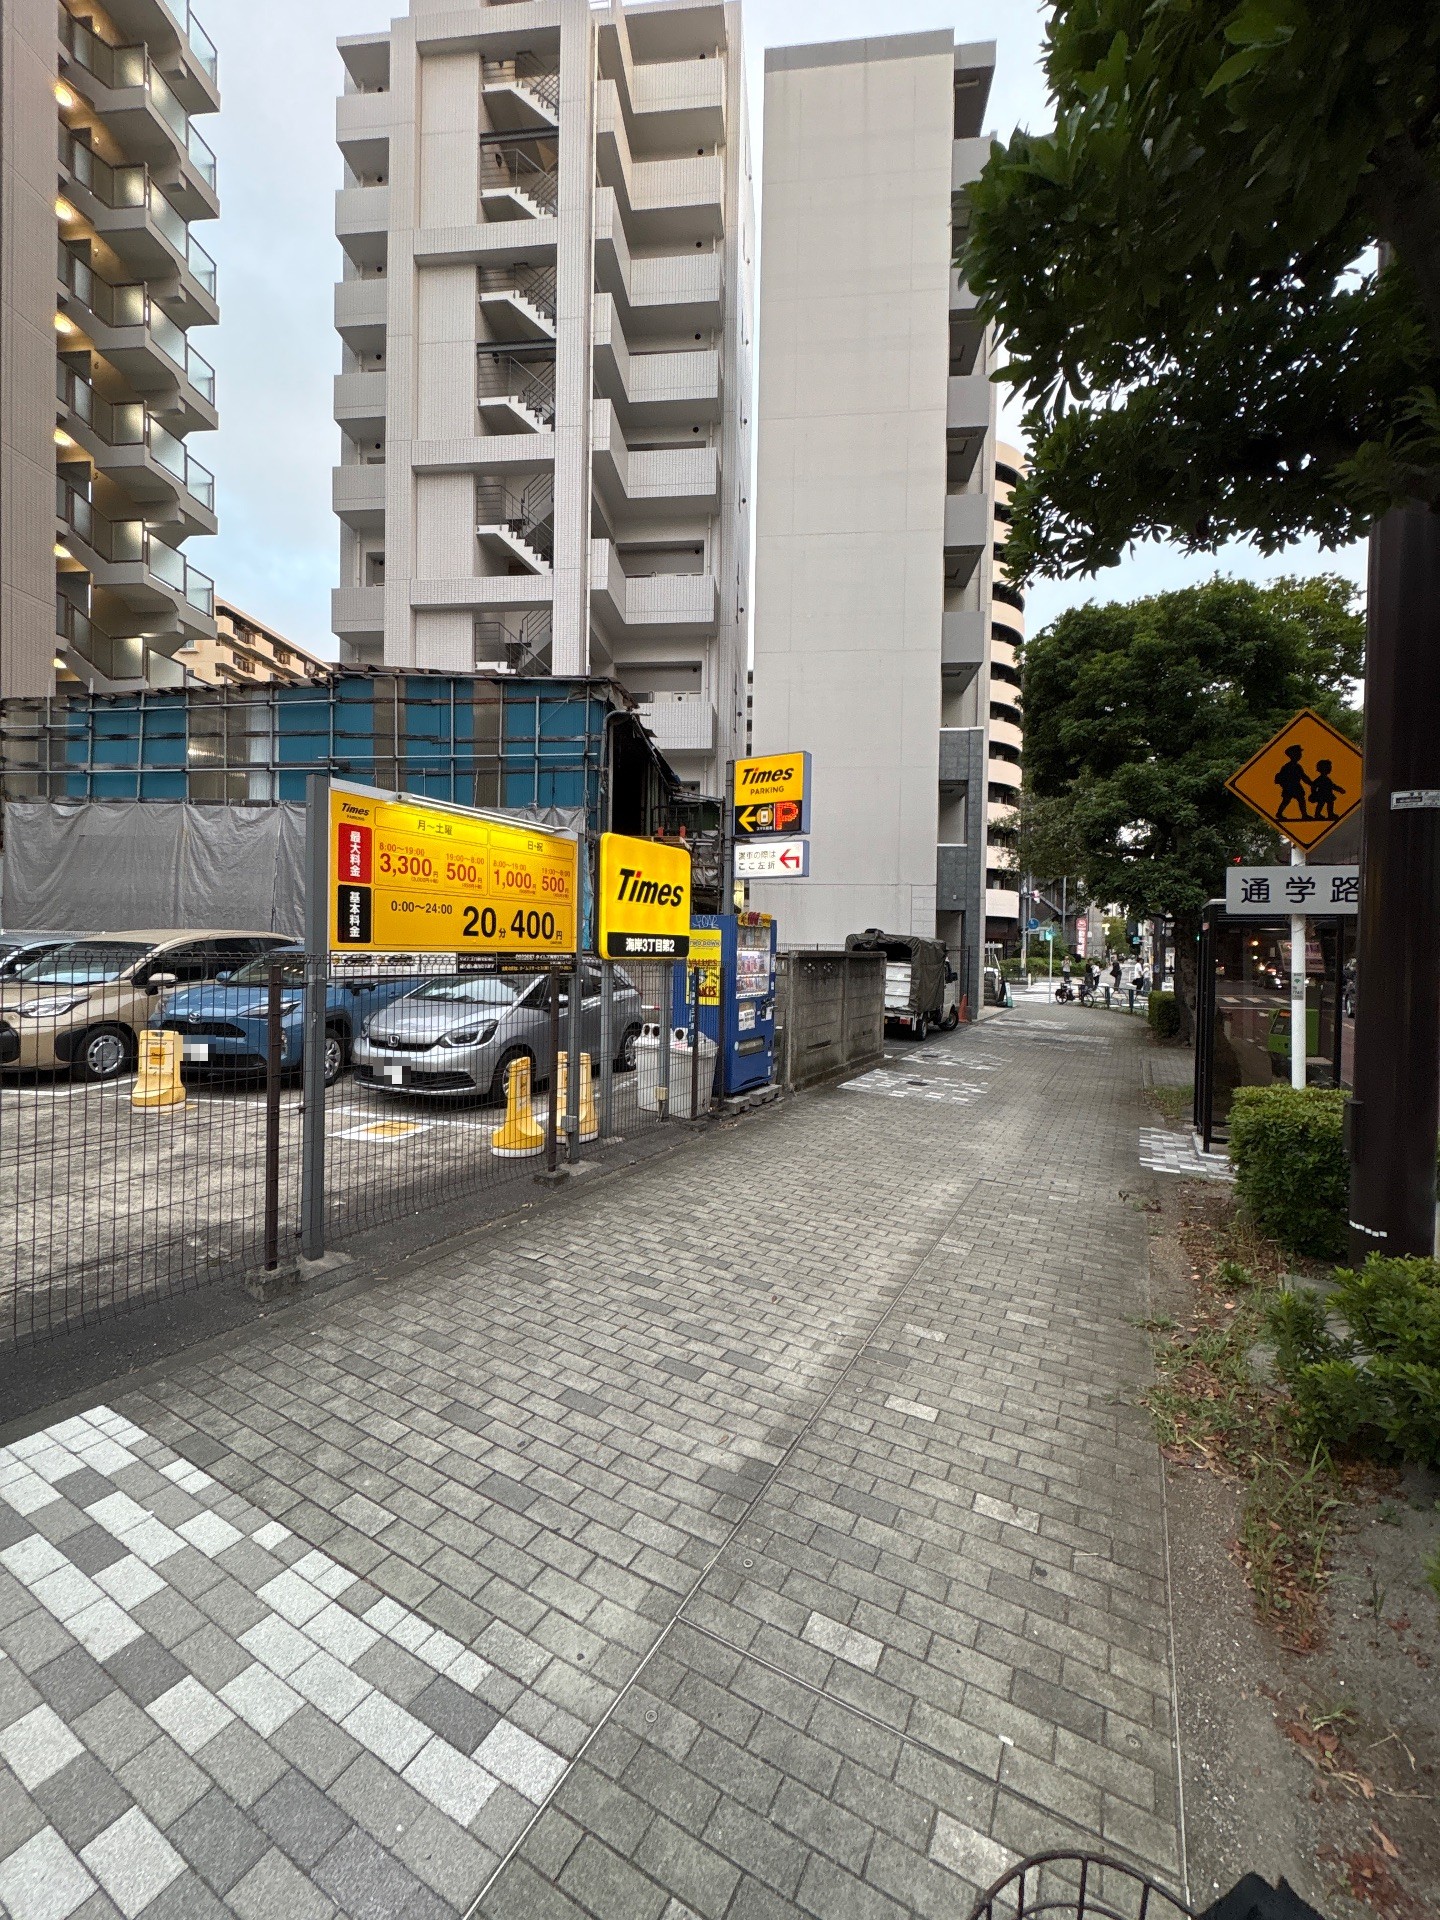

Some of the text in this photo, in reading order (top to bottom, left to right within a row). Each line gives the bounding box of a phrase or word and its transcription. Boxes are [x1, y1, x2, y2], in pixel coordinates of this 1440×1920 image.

[742, 767, 794, 785] Times
[750, 786, 784, 796] PARKING
[341, 803, 370, 816] Times
[775, 802, 799, 831] P
[417, 819, 453, 836] 月～土曜
[350, 830, 361, 877] 最大料金
[739, 861, 775, 870] ここ左折
[618, 868, 684, 907] Times
[1241, 876, 1359, 903] 通学路
[349, 891, 360, 937] 基本料金
[391, 900, 453, 914] 0:00～24:00
[625, 937, 675, 952] 海岸3丁目第2
